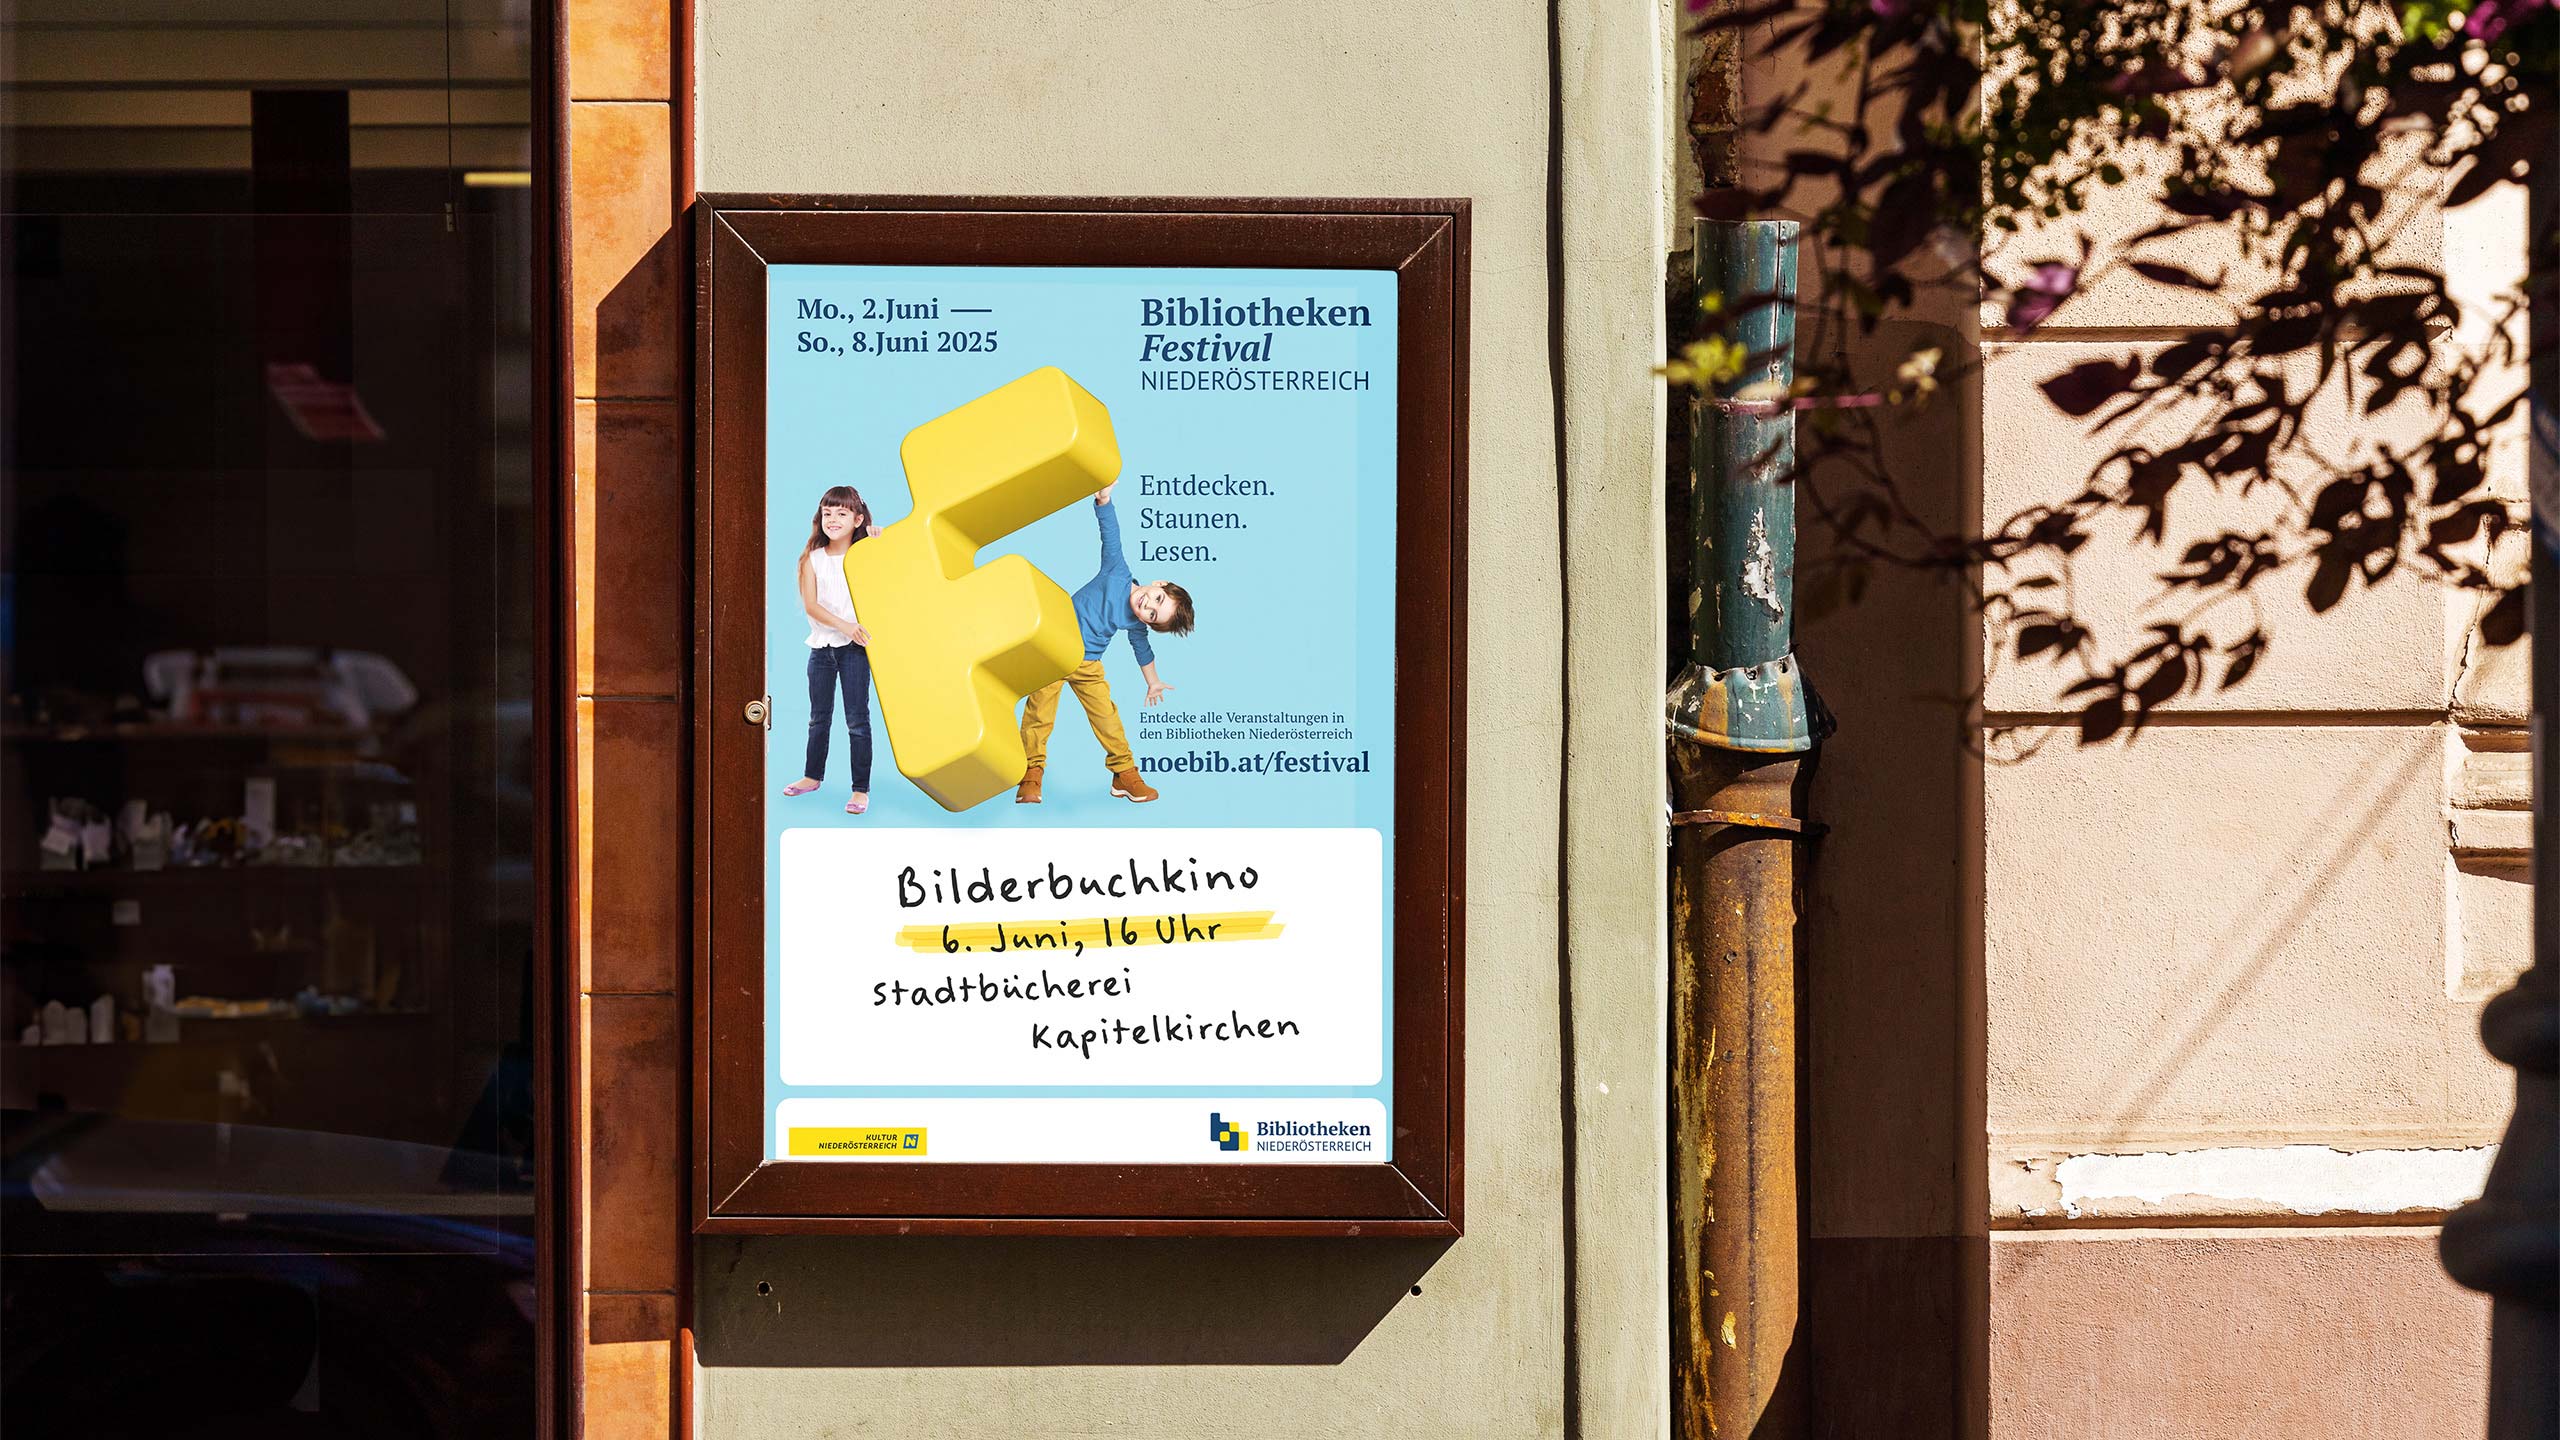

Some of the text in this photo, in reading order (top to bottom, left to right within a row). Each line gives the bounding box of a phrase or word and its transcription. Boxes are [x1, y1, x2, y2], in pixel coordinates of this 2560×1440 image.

[797, 298, 854, 324] Mo.,
[863, 297, 939, 324] 2.Juni
[1140, 297, 1373, 327] Bibliotheken
[797, 330, 998, 358] So., 8.Juni 2025
[1138, 333, 1272, 364] Festival
[1141, 367, 1369, 392] NIEDERÖSTERREICH
[1140, 473, 1275, 497] Entdecken.
[1140, 507, 1248, 531] Staunen.
[1140, 540, 1217, 563] Lesen.
[1139, 711, 1345, 727] Entdecke alle Veranstaltungen in
[1139, 727, 1353, 740] den Bibliotheken Niederösterreich
[1139, 749, 1370, 775] noebib.at/festival
[897, 857, 1260, 909] Bilderbuchkino
[942, 916, 1224, 957] 6. Juni, 16 Uhr
[865, 1133, 898, 1141] KULTUR
[1256, 1119, 1372, 1138] Bibliotheken
[818, 1140, 898, 1150] NIEDERÖSTERREICH
[1256, 1138, 1372, 1152] NIEDERÖSTERREICH
